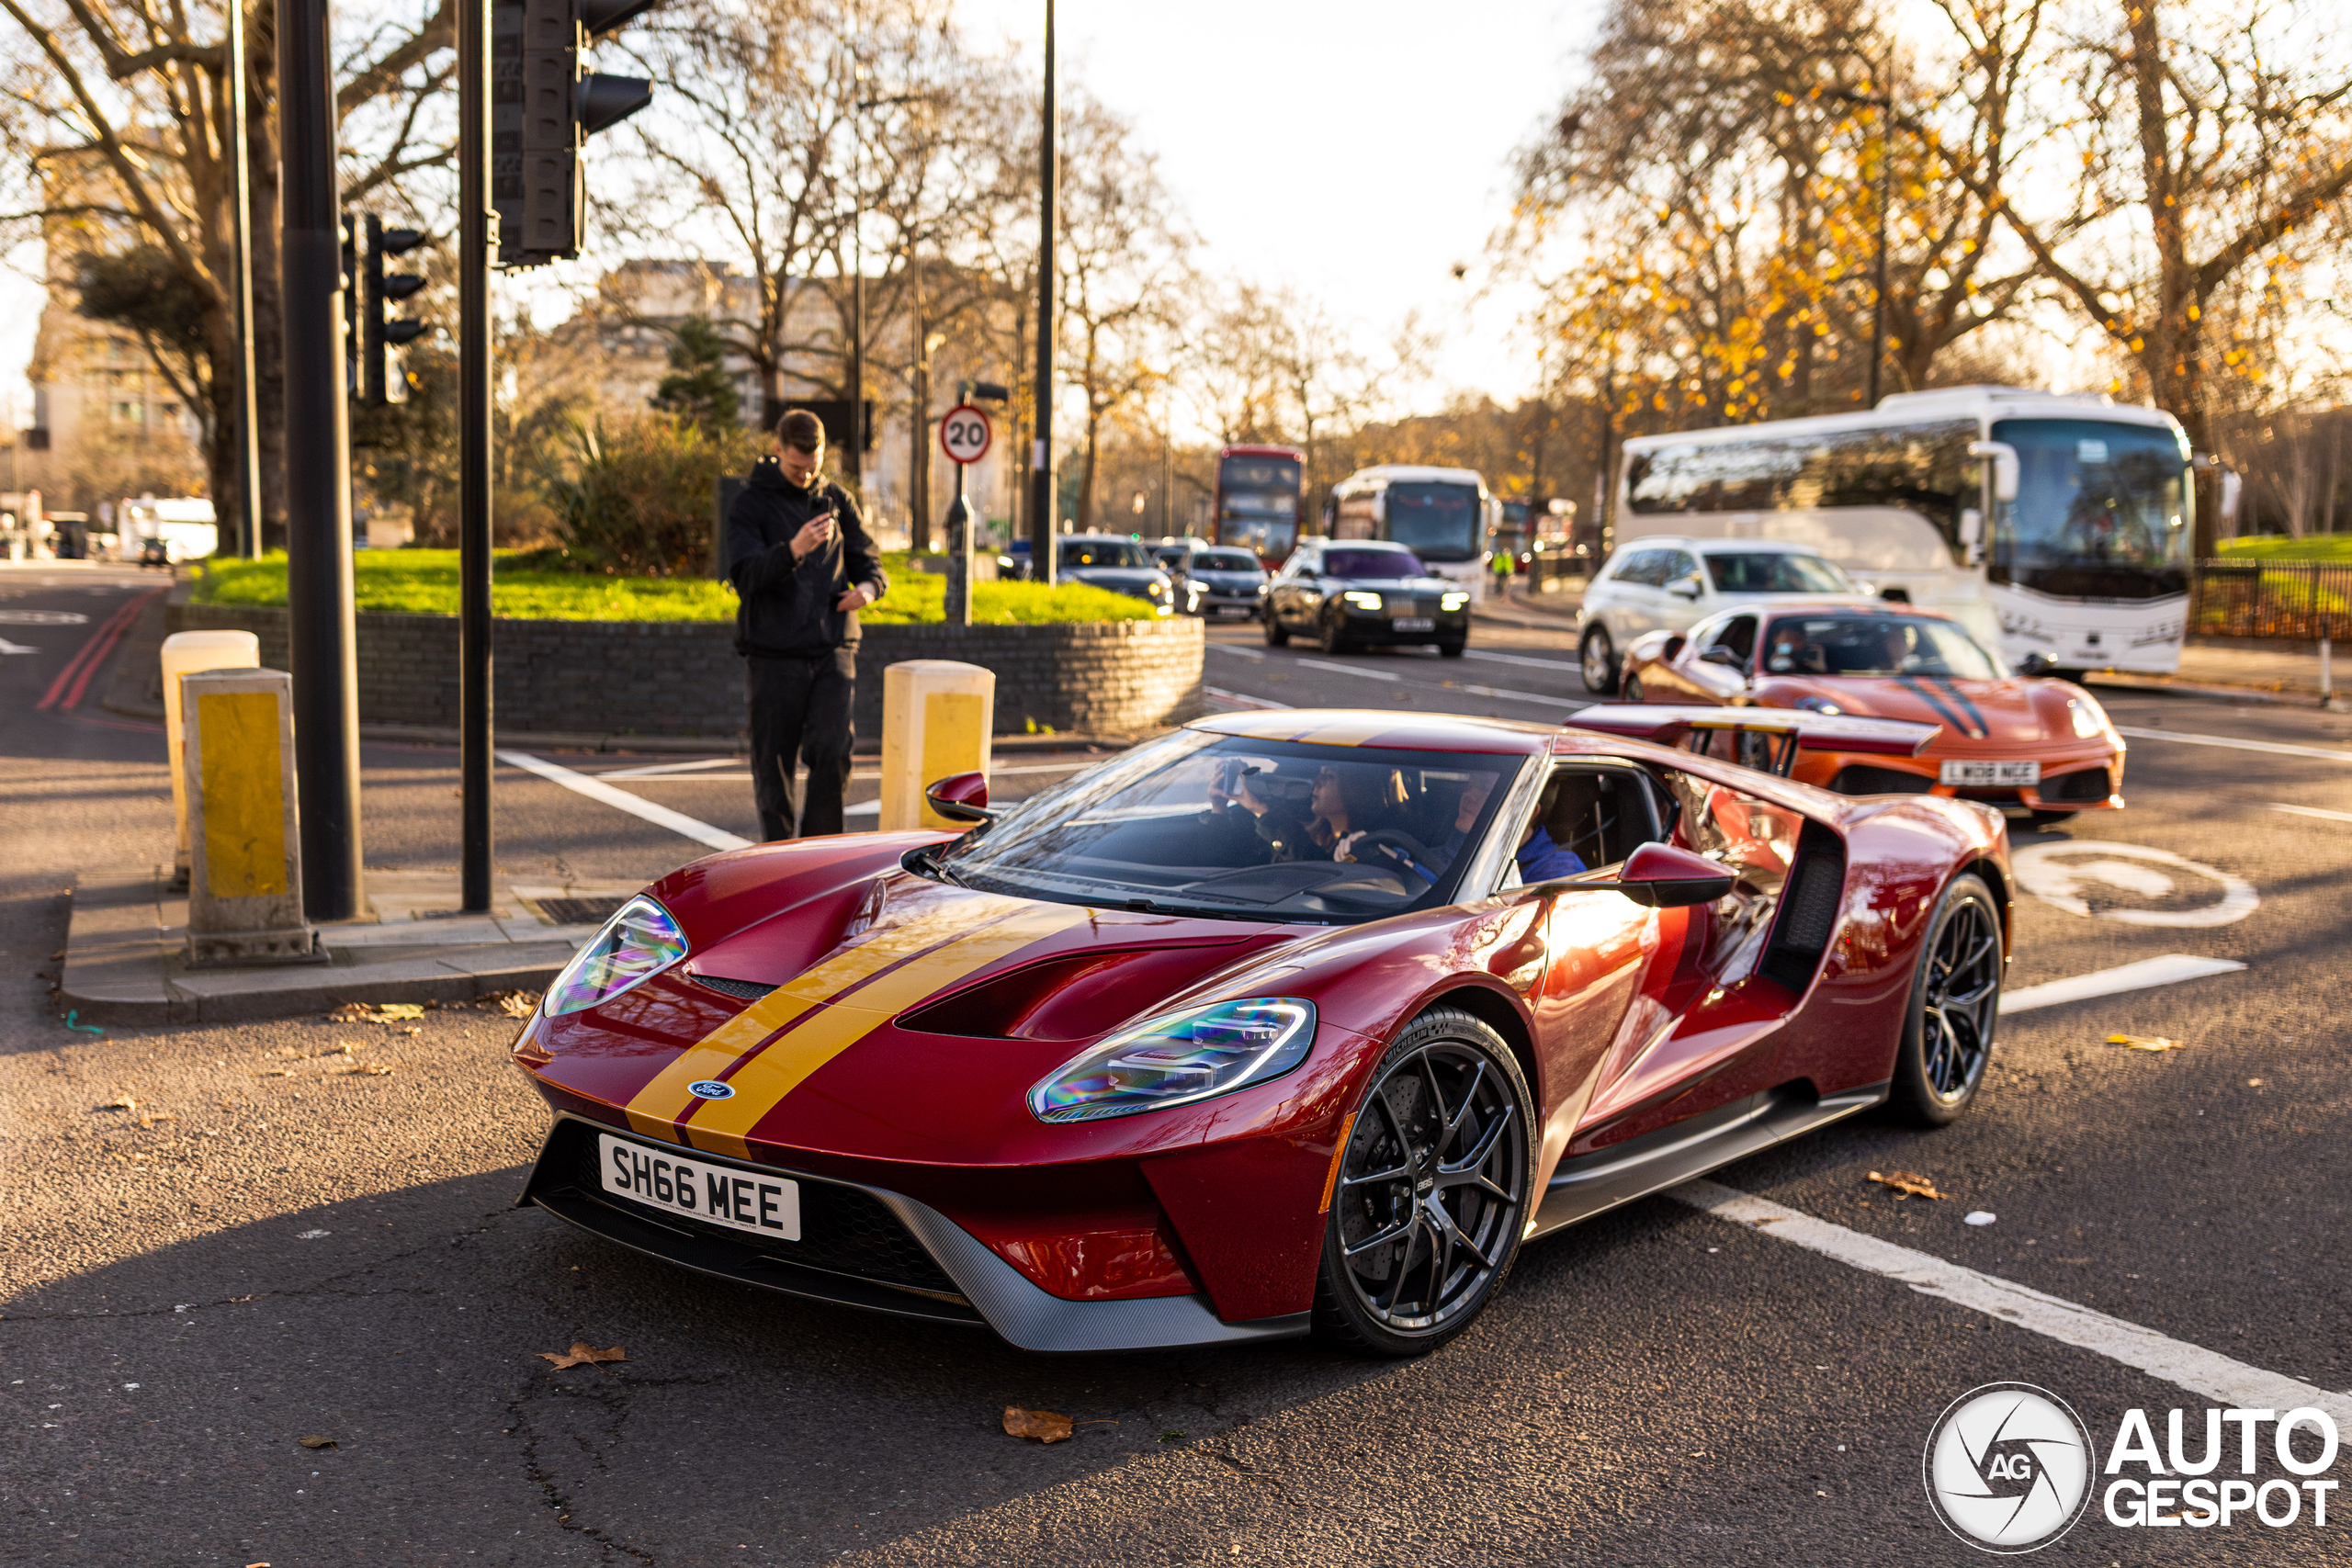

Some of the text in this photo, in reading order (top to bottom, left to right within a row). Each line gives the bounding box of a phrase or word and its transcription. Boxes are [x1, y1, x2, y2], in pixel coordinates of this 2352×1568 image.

[949, 421, 984, 447] 20
[1384, 1028, 1430, 1064] MICHELIN
[695, 1083, 726, 1096] Ford
[613, 1145, 784, 1231] SH66 MEE
[1417, 1177, 1433, 1191] BBS
